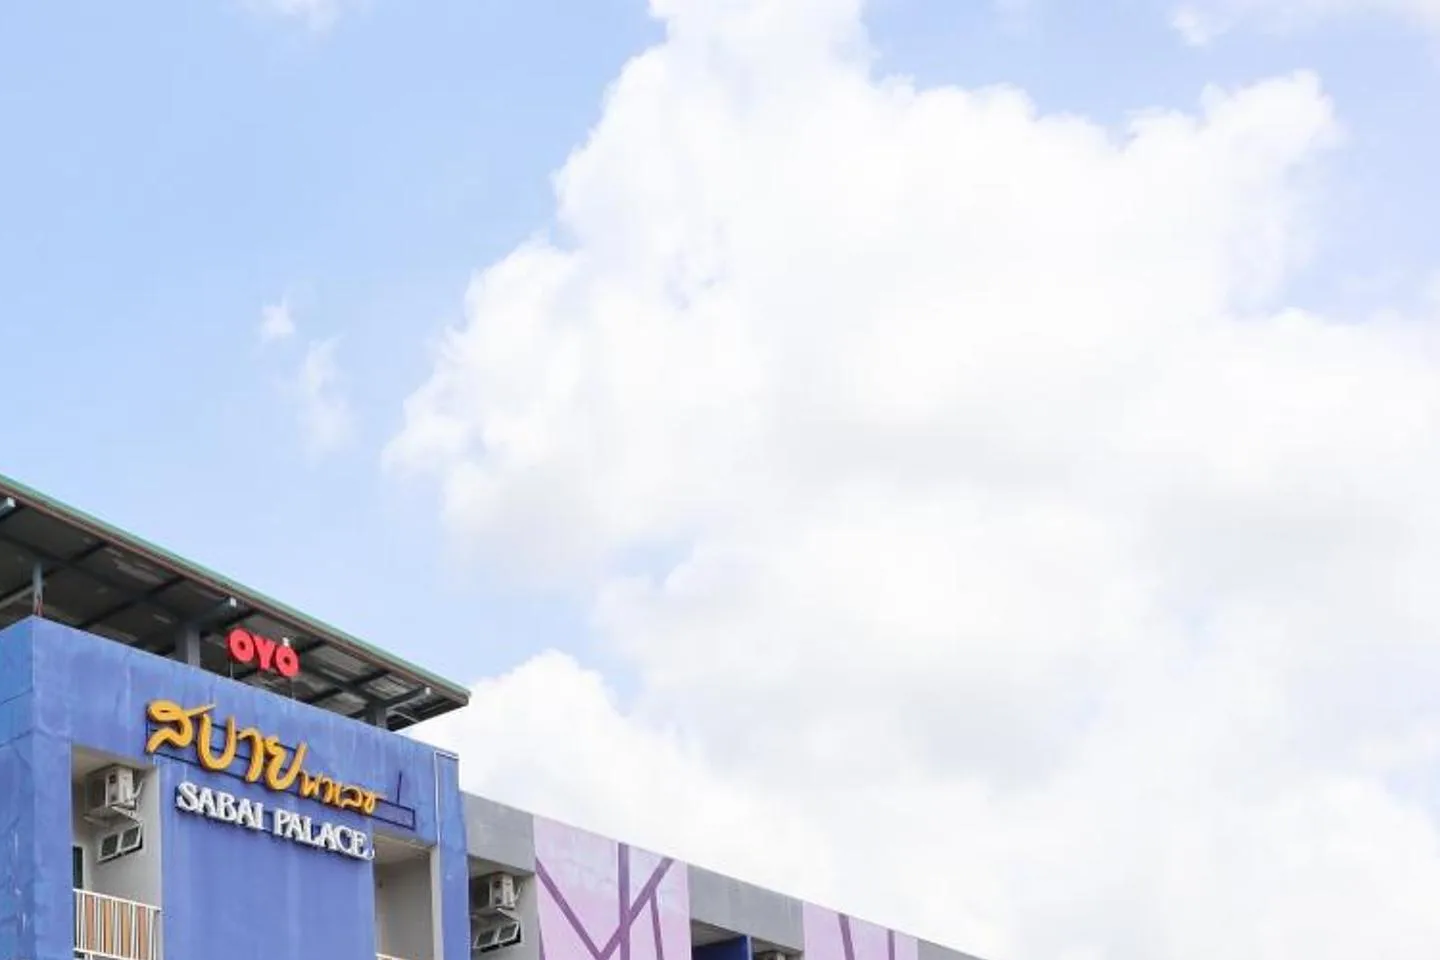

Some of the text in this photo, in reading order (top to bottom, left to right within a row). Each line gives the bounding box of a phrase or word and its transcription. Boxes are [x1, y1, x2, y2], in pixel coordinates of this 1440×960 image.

[227, 627, 300, 677] OYO
[146, 700, 308, 790] สบาย
[177, 781, 375, 860] SABAI PALACE
